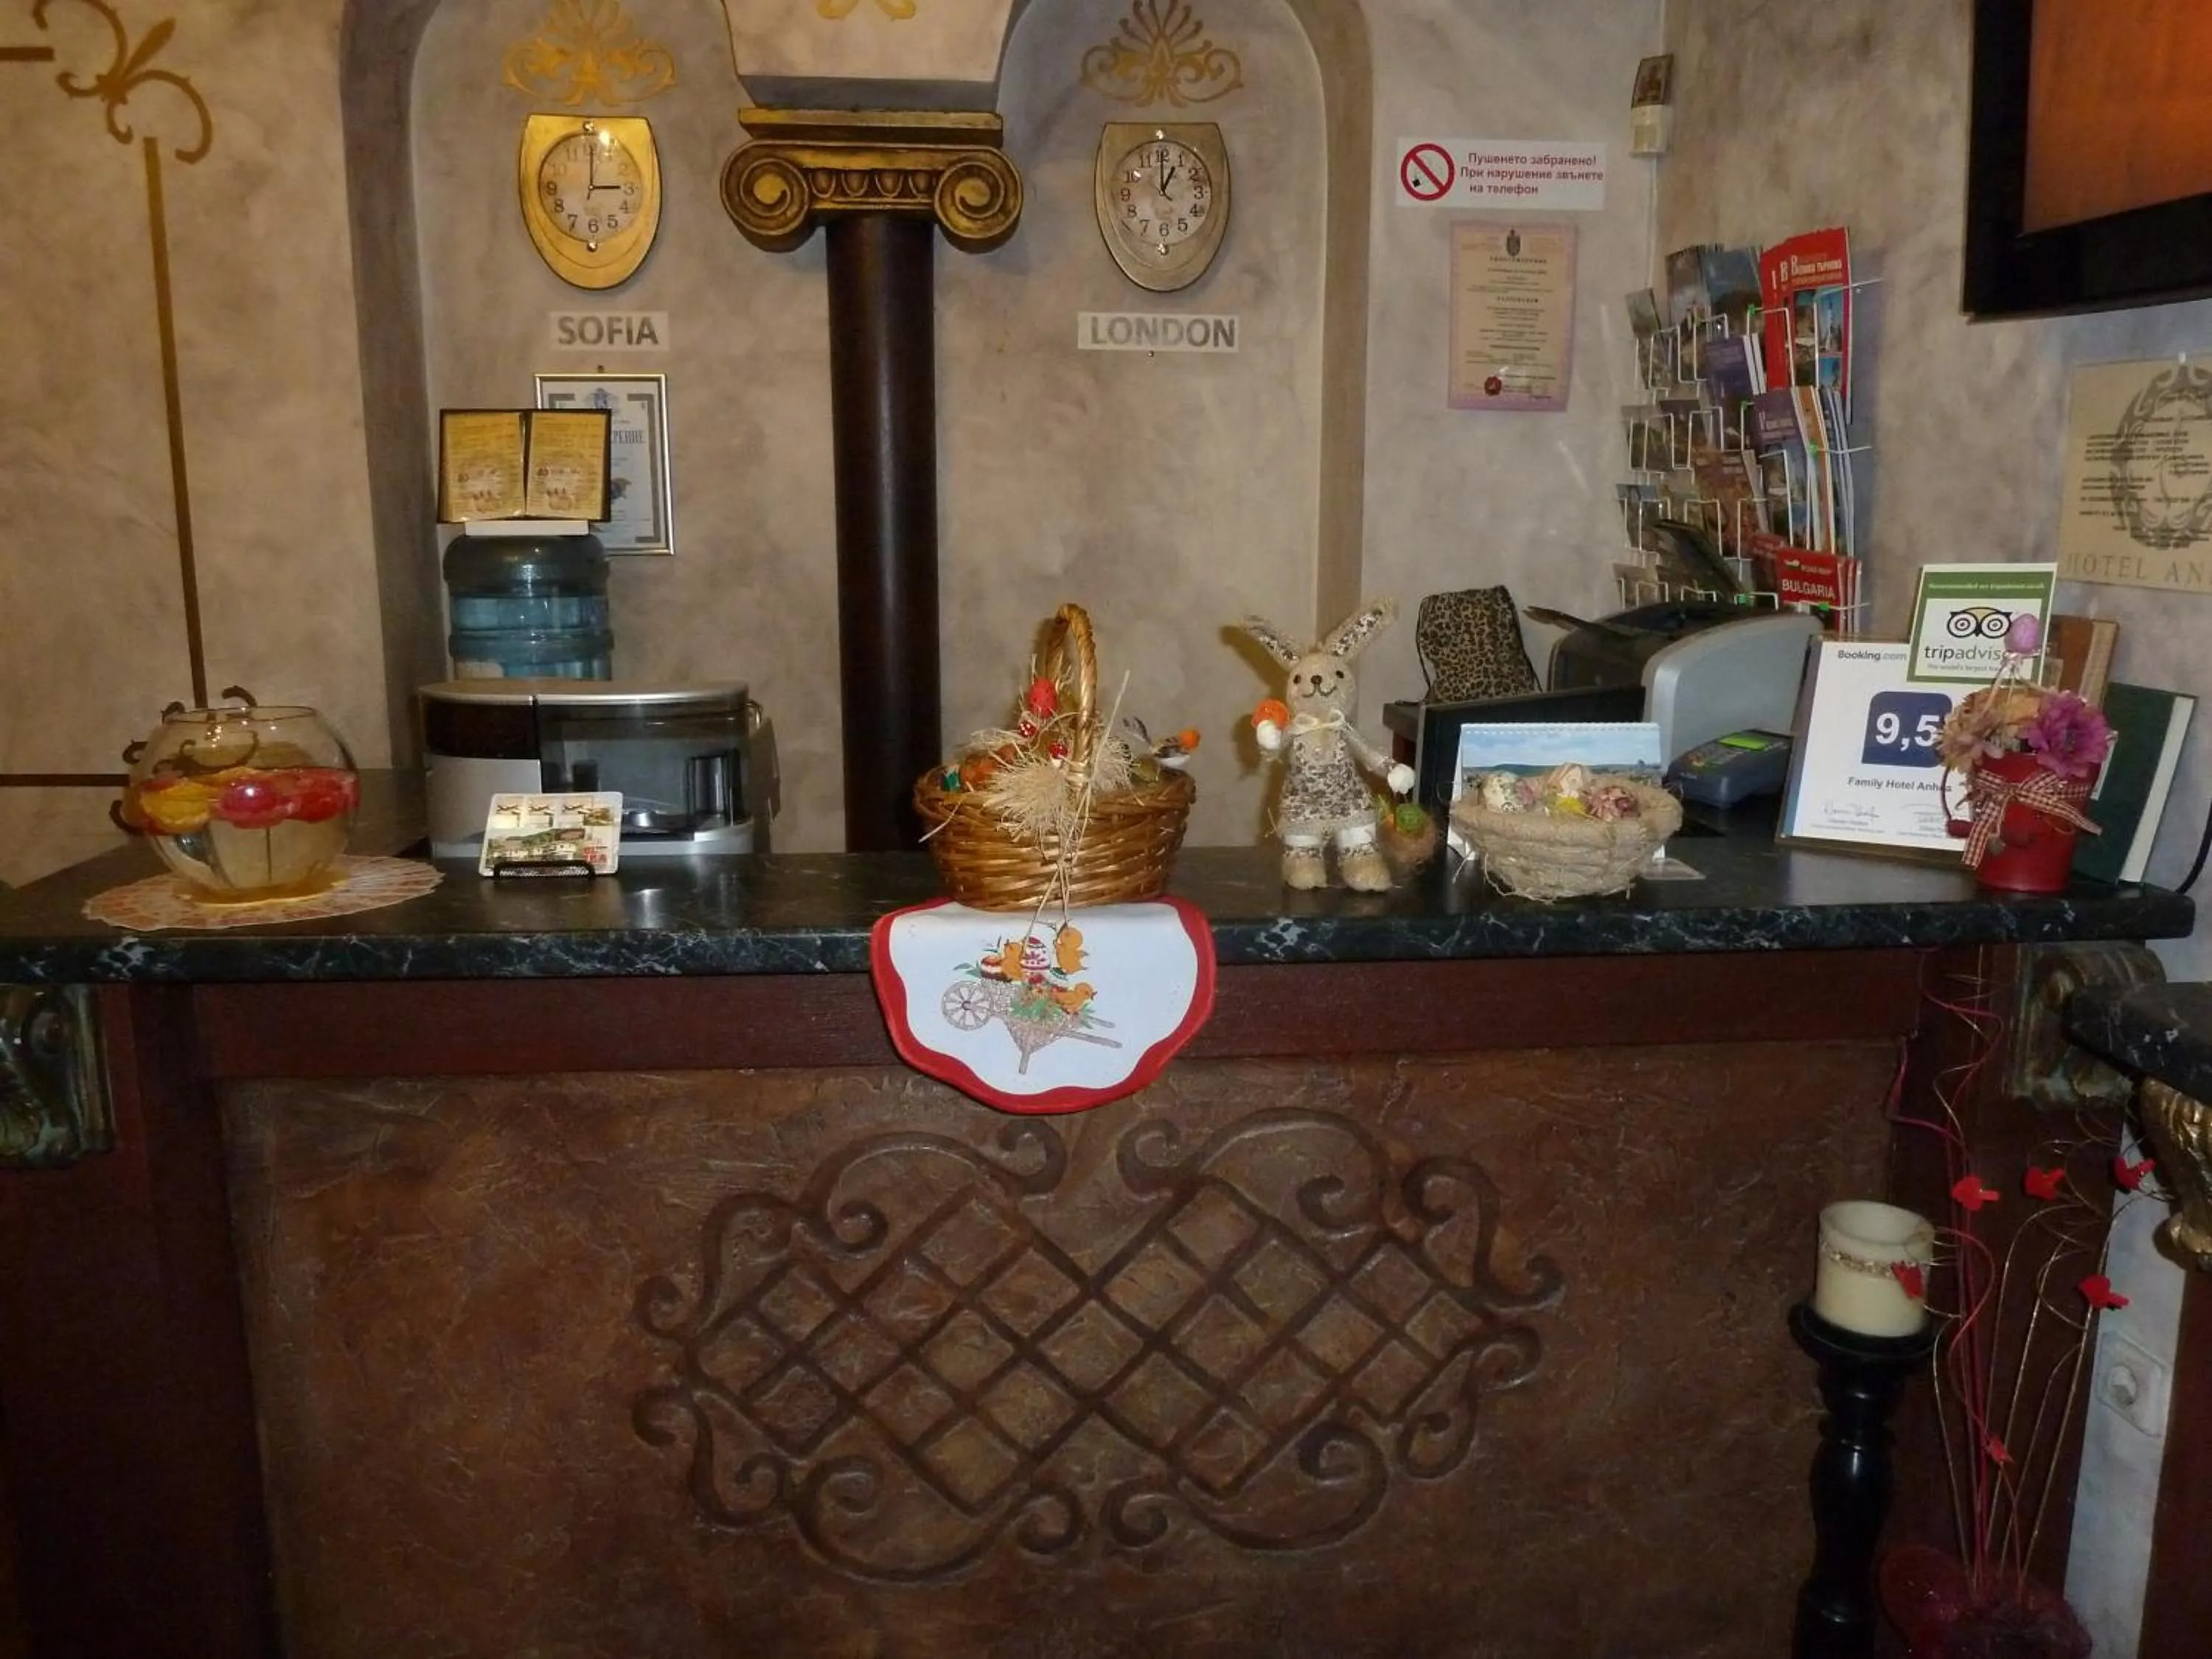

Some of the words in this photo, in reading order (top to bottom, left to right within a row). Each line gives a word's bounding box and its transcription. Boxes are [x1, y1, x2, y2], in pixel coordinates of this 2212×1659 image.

[1468, 153, 1527, 164] Пушенето
[1530, 153, 1596, 167] забранено!
[1460, 167, 1484, 178] При
[1486, 169, 1552, 181] нарушение
[1555, 170, 1604, 181] звънете
[1120, 188, 1131, 202] 9
[1194, 186, 1204, 200] 3
[1470, 185, 1484, 193] на
[1486, 184, 1539, 195] телефон
[554, 198, 565, 212] 8
[1127, 205, 1138, 218] 8
[1189, 204, 1199, 218] 4
[588, 218, 599, 234] 6
[607, 215, 618, 229] 5
[1178, 218, 1188, 232] 5
[1159, 223, 1169, 237] 6
[557, 316, 659, 345] SOFIA
[1091, 316, 1236, 348] LONDON
[2164, 560, 2212, 586] AN
[1782, 579, 1835, 599] BULGARIA
[1837, 650, 1907, 661] Booking.com
[1875, 712, 1940, 751] 9,5
[1847, 776, 1883, 790] Family
[1886, 779, 1915, 790] Hotel
[1917, 782, 1952, 792] Anha
